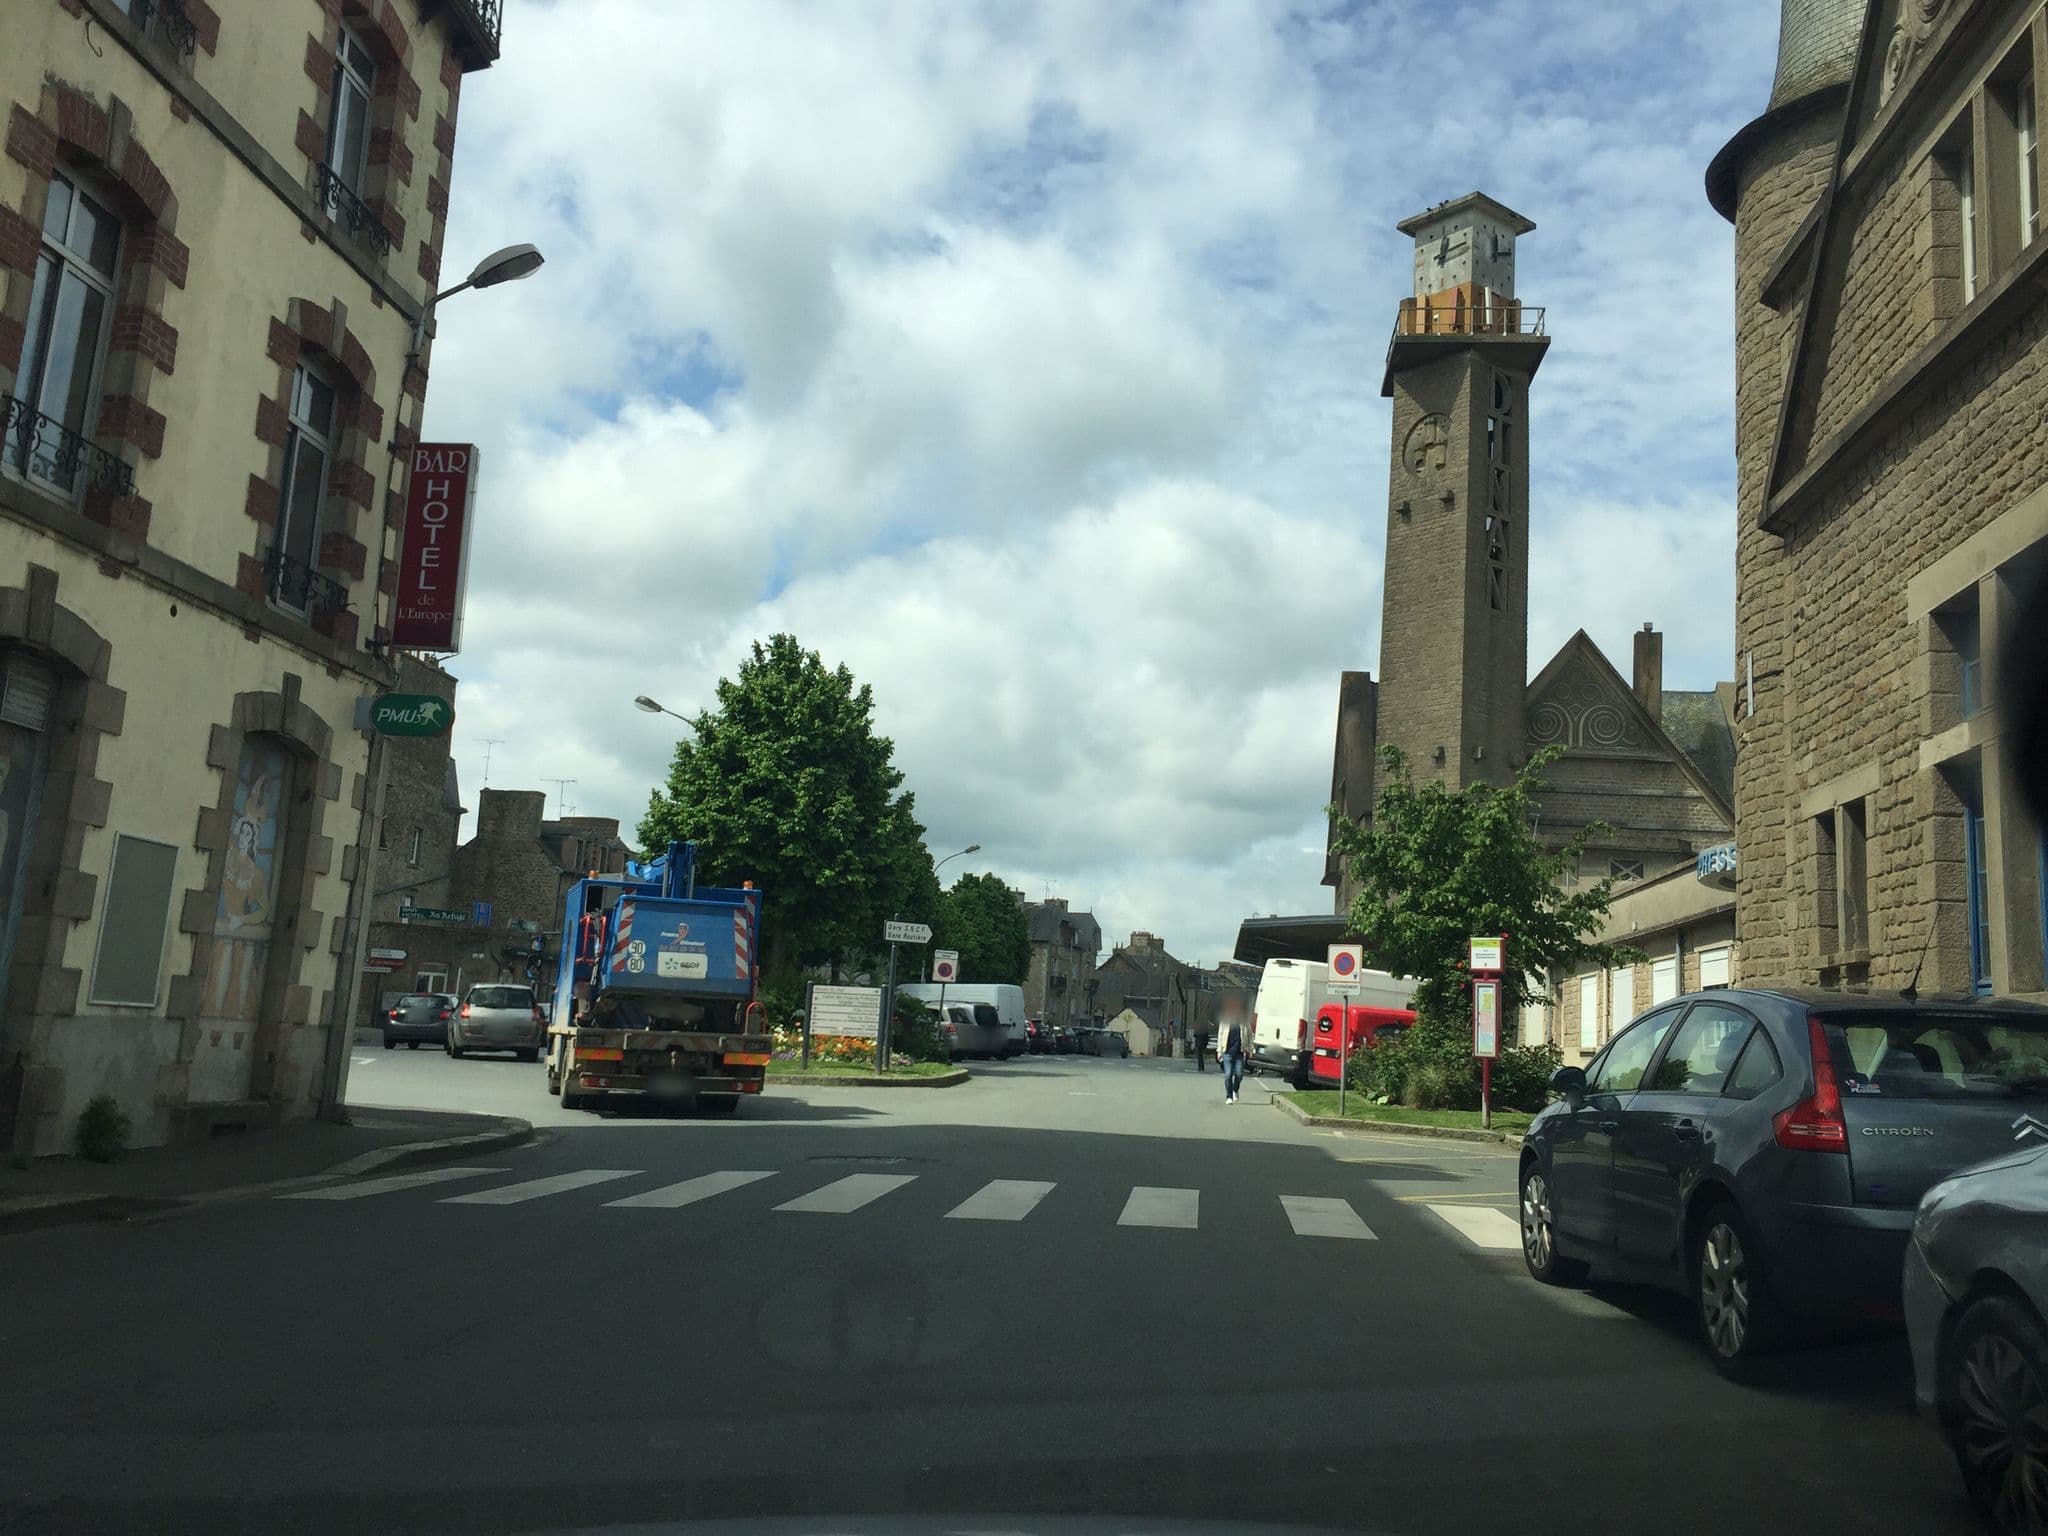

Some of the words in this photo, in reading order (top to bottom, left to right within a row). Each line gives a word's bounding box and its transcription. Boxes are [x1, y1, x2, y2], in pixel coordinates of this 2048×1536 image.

[414, 449, 467, 474] BAR
[418, 479, 450, 590] HOTEL
[417, 593, 435, 606] de
[399, 607, 452, 624] L'Europe
[377, 708, 418, 723] PMU
[888, 923, 902, 931] Gare
[887, 931, 901, 939] Gare
[631, 941, 644, 955] 90
[630, 958, 642, 971] 80
